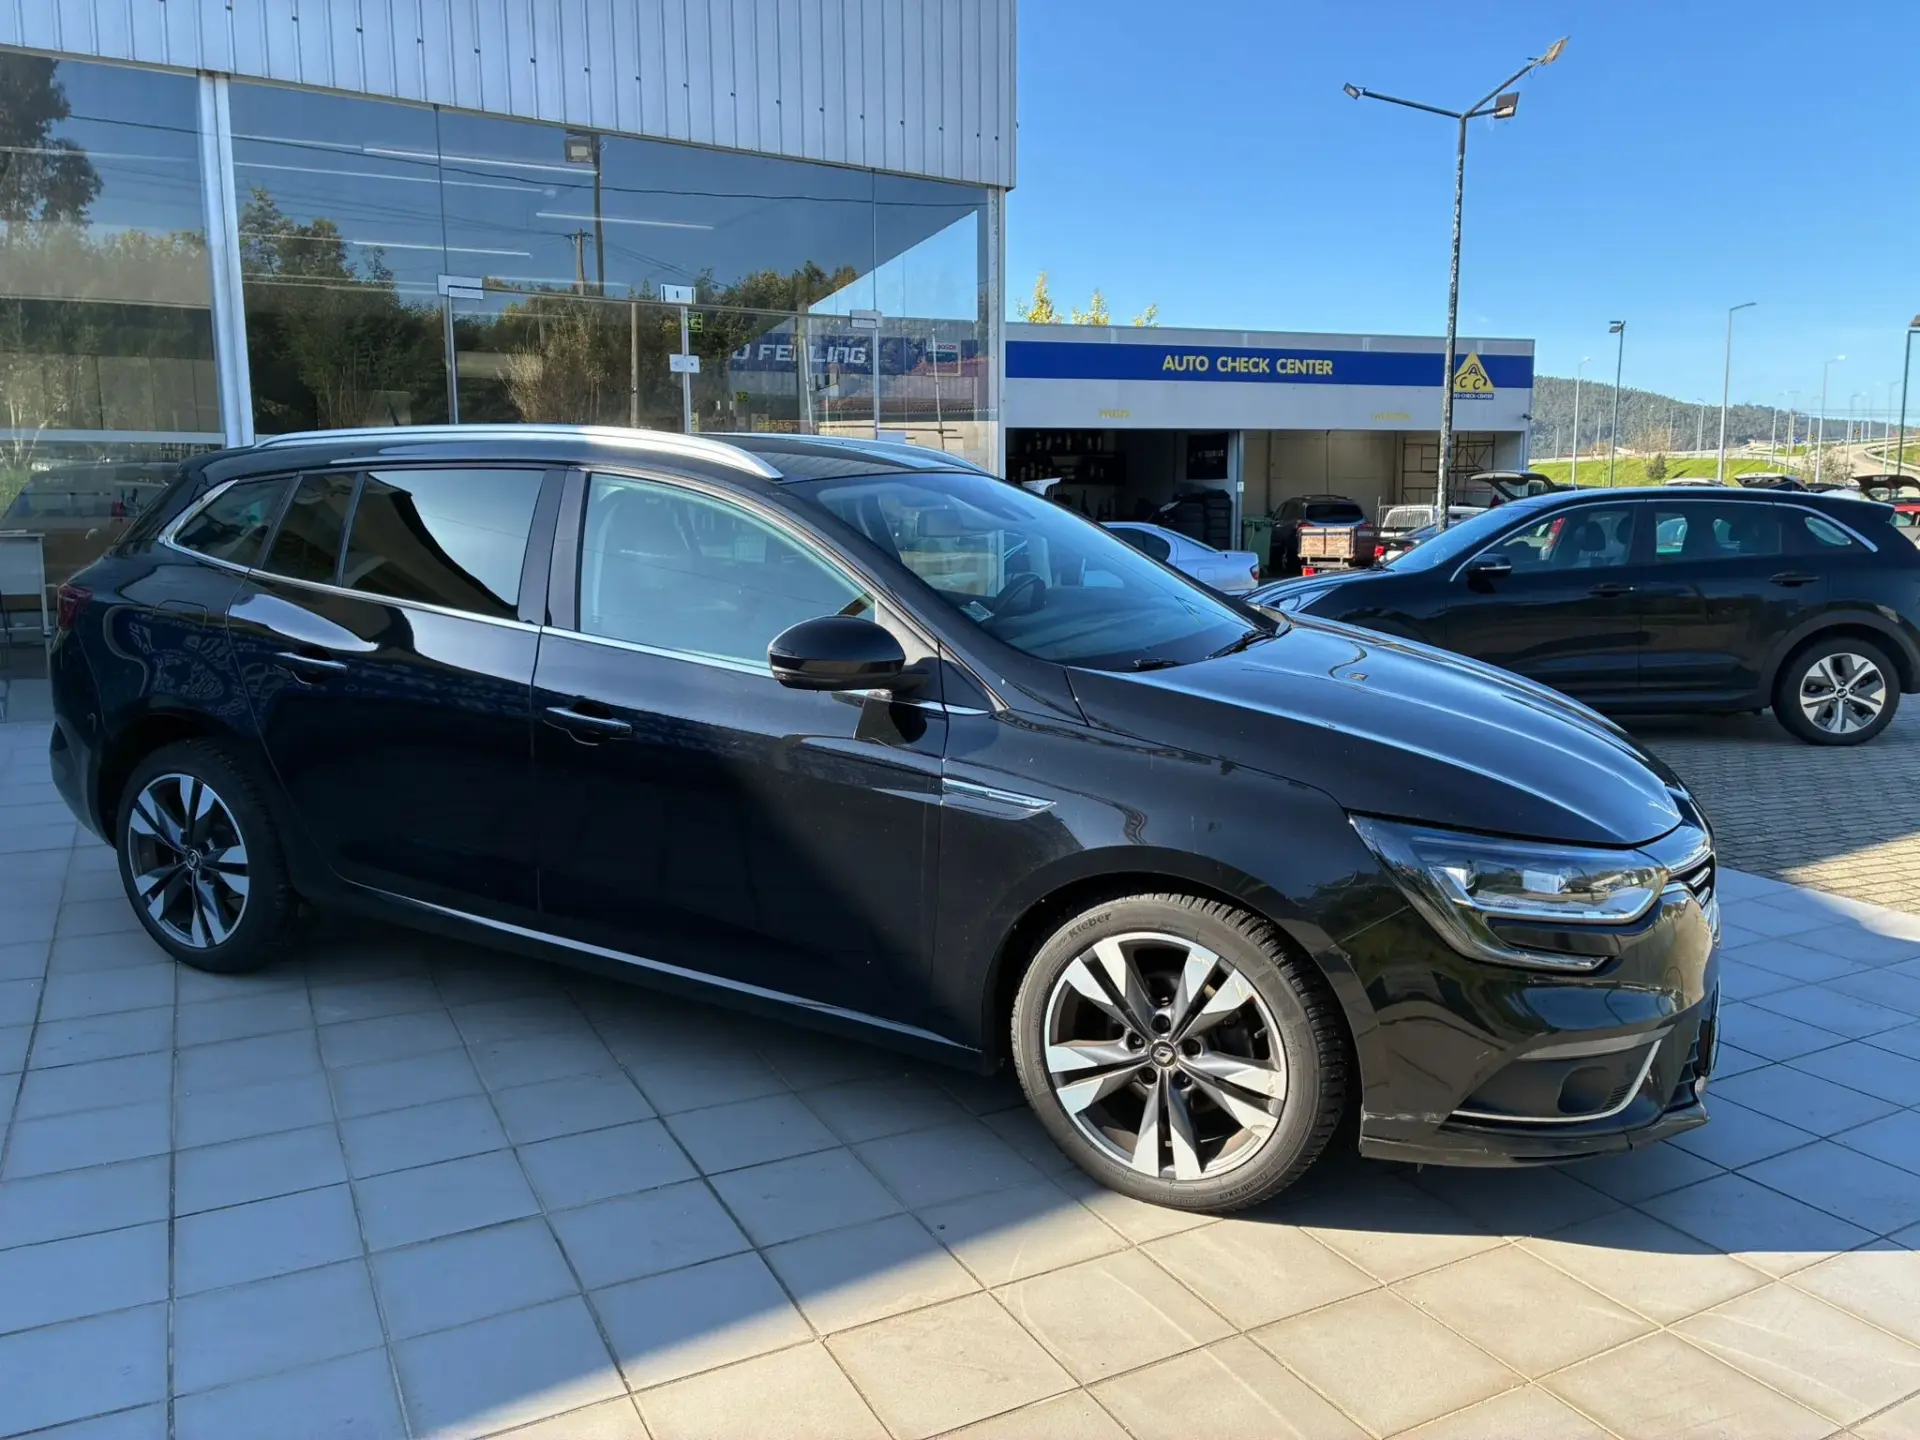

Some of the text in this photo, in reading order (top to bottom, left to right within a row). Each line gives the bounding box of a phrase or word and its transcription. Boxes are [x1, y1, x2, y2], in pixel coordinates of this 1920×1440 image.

[757, 344, 867, 364] FELING
[1162, 355, 1333, 376] AUTO CHECK CENTER
[1068, 912, 1112, 939] Kleber
